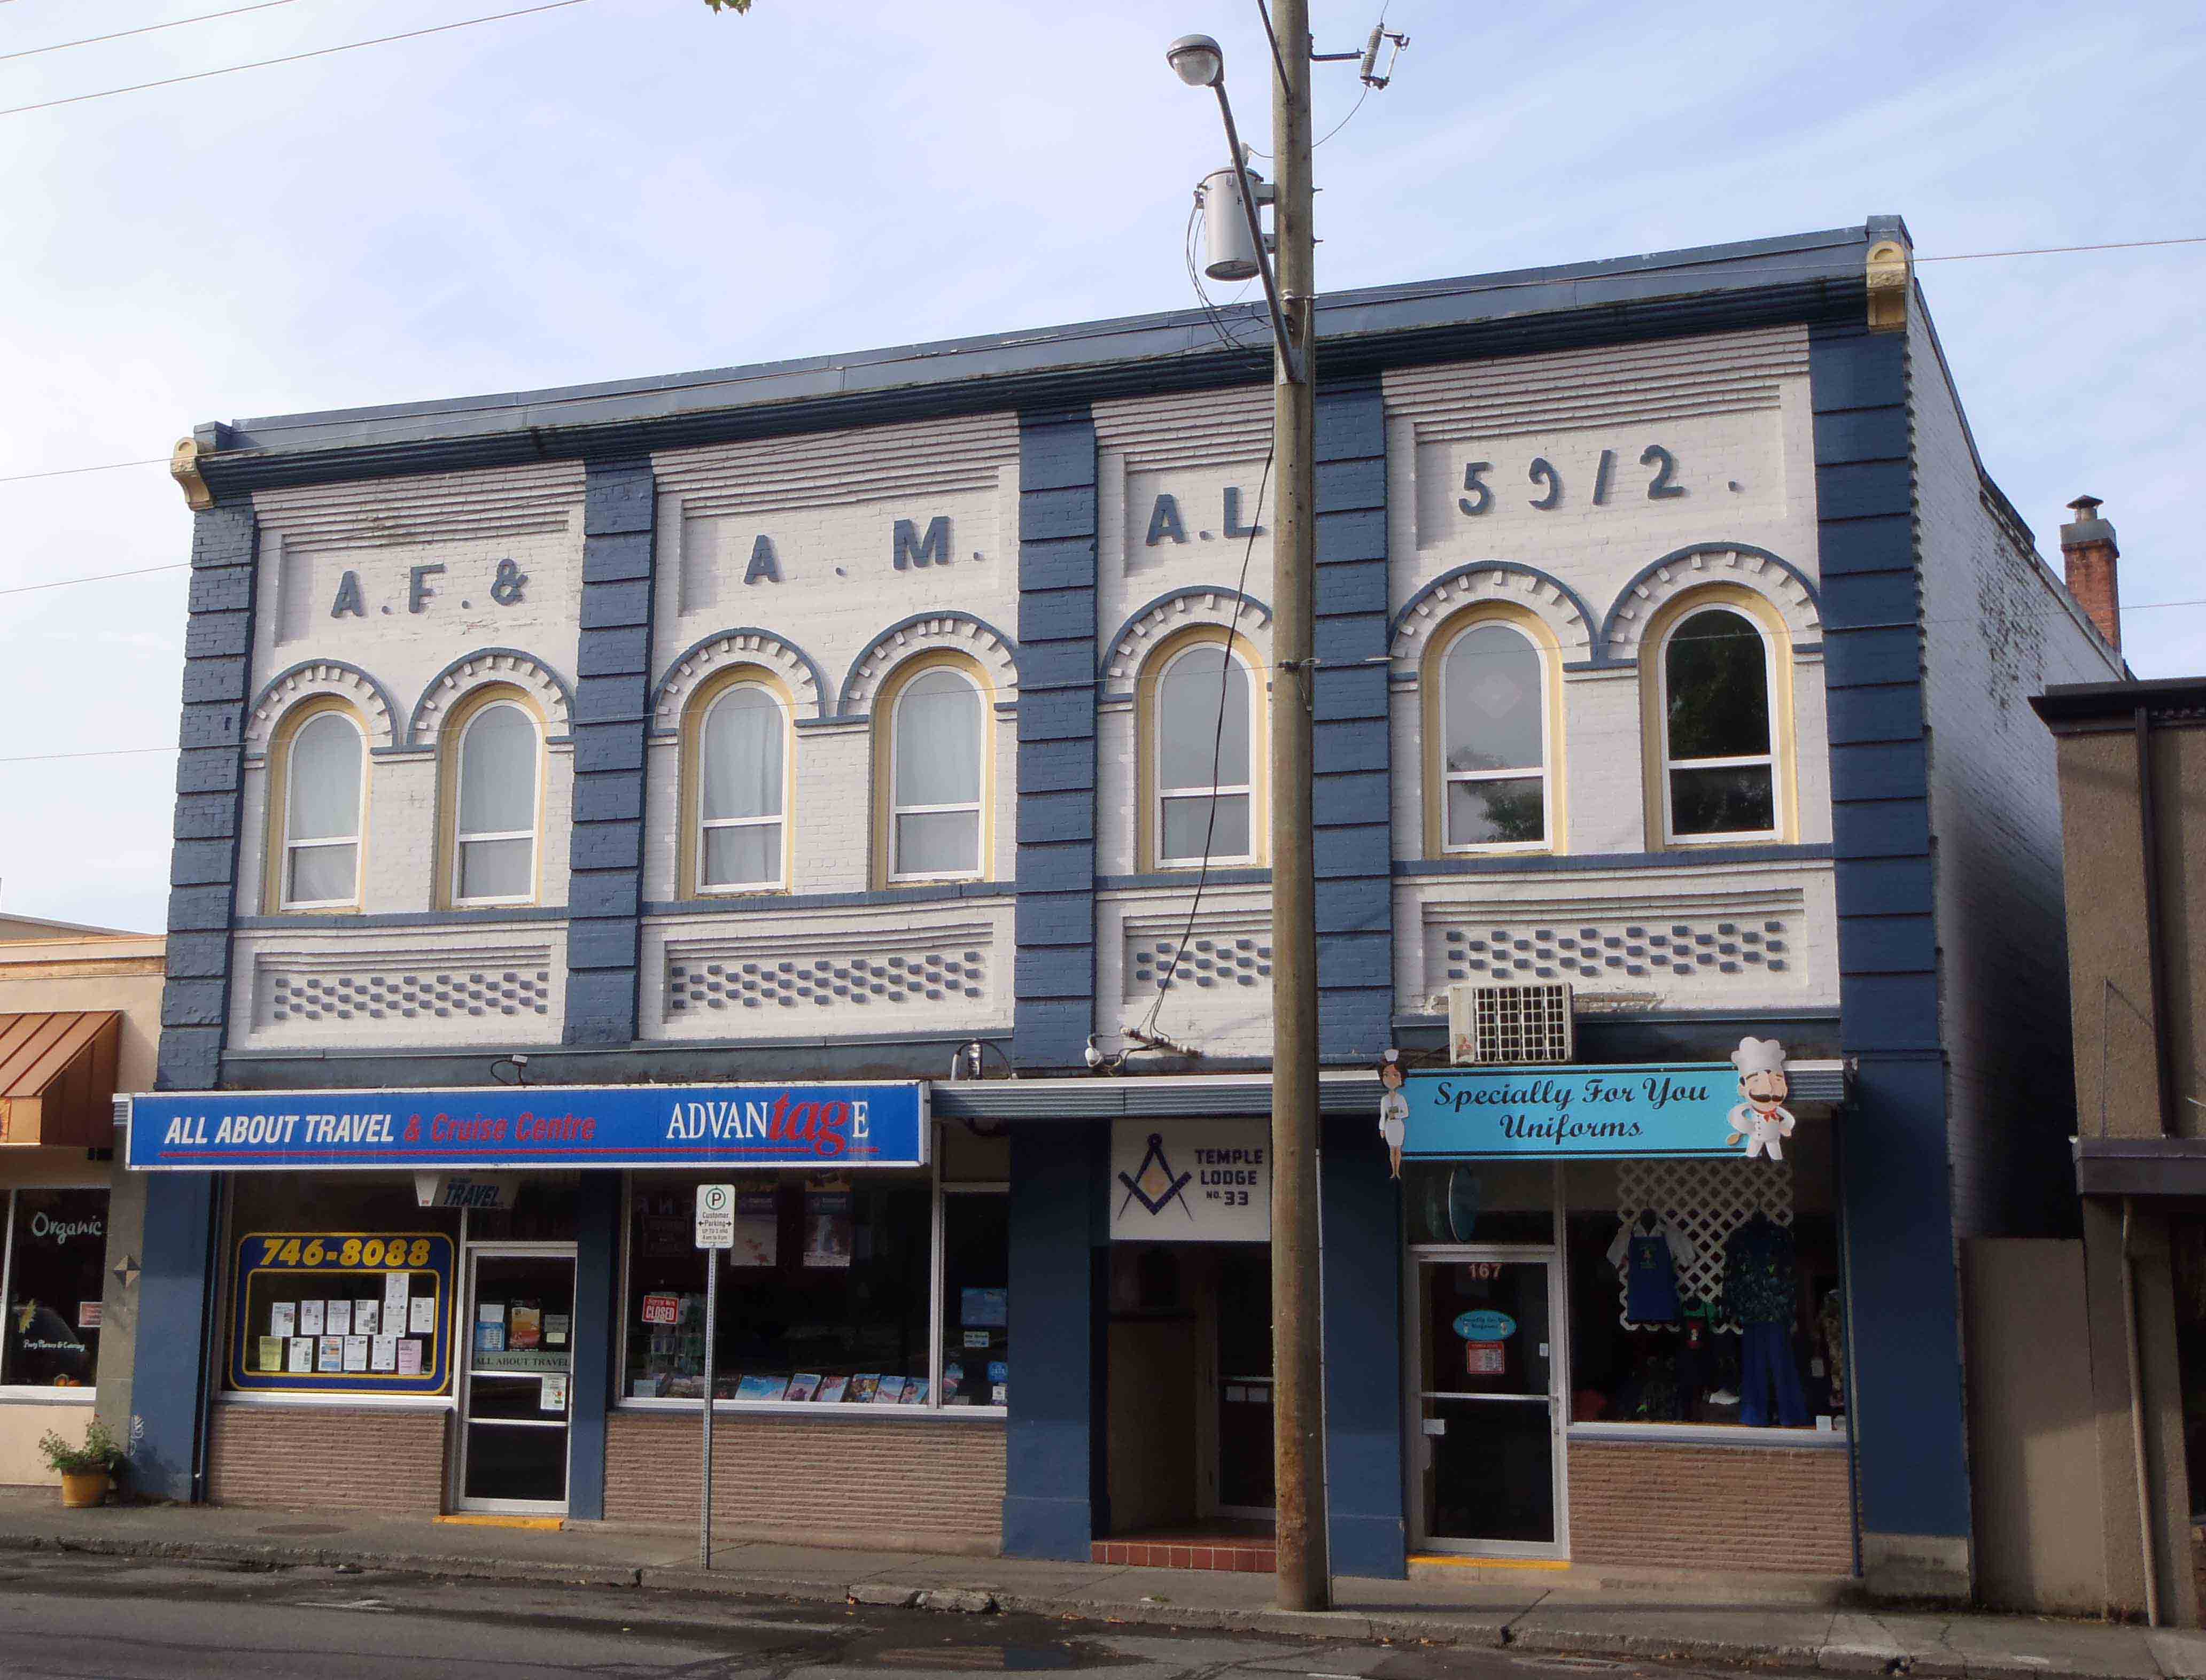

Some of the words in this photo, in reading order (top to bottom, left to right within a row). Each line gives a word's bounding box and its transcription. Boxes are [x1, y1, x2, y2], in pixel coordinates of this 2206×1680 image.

[1434, 1079, 1574, 1113] Specially
[1582, 1078, 1635, 1104] For
[1642, 1077, 1710, 1110] You
[164, 1116, 208, 1144] ALL
[215, 1115, 299, 1144] ABOUT
[306, 1114, 394, 1142] TRAVEL
[404, 1113, 422, 1142] &
[431, 1113, 509, 1142] Cruise
[515, 1111, 596, 1141] Centre
[1500, 1114, 1643, 1145] Uniforms
[1195, 1149, 1263, 1164] TEMPLE
[1200, 1170, 1257, 1185] LODGE
[1224, 1191, 1248, 1205] 33
[32, 1211, 103, 1244] Organic
[704, 1219, 726, 1228] Parking
[260, 1239, 431, 1266] 746-8088
[1469, 1263, 1501, 1278] 167
[646, 1305, 674, 1320] CLOSED
[477, 1357, 493, 1365] ALL
[496, 1357, 529, 1366] ABOUT
[533, 1358, 569, 1367] TRAVEL
